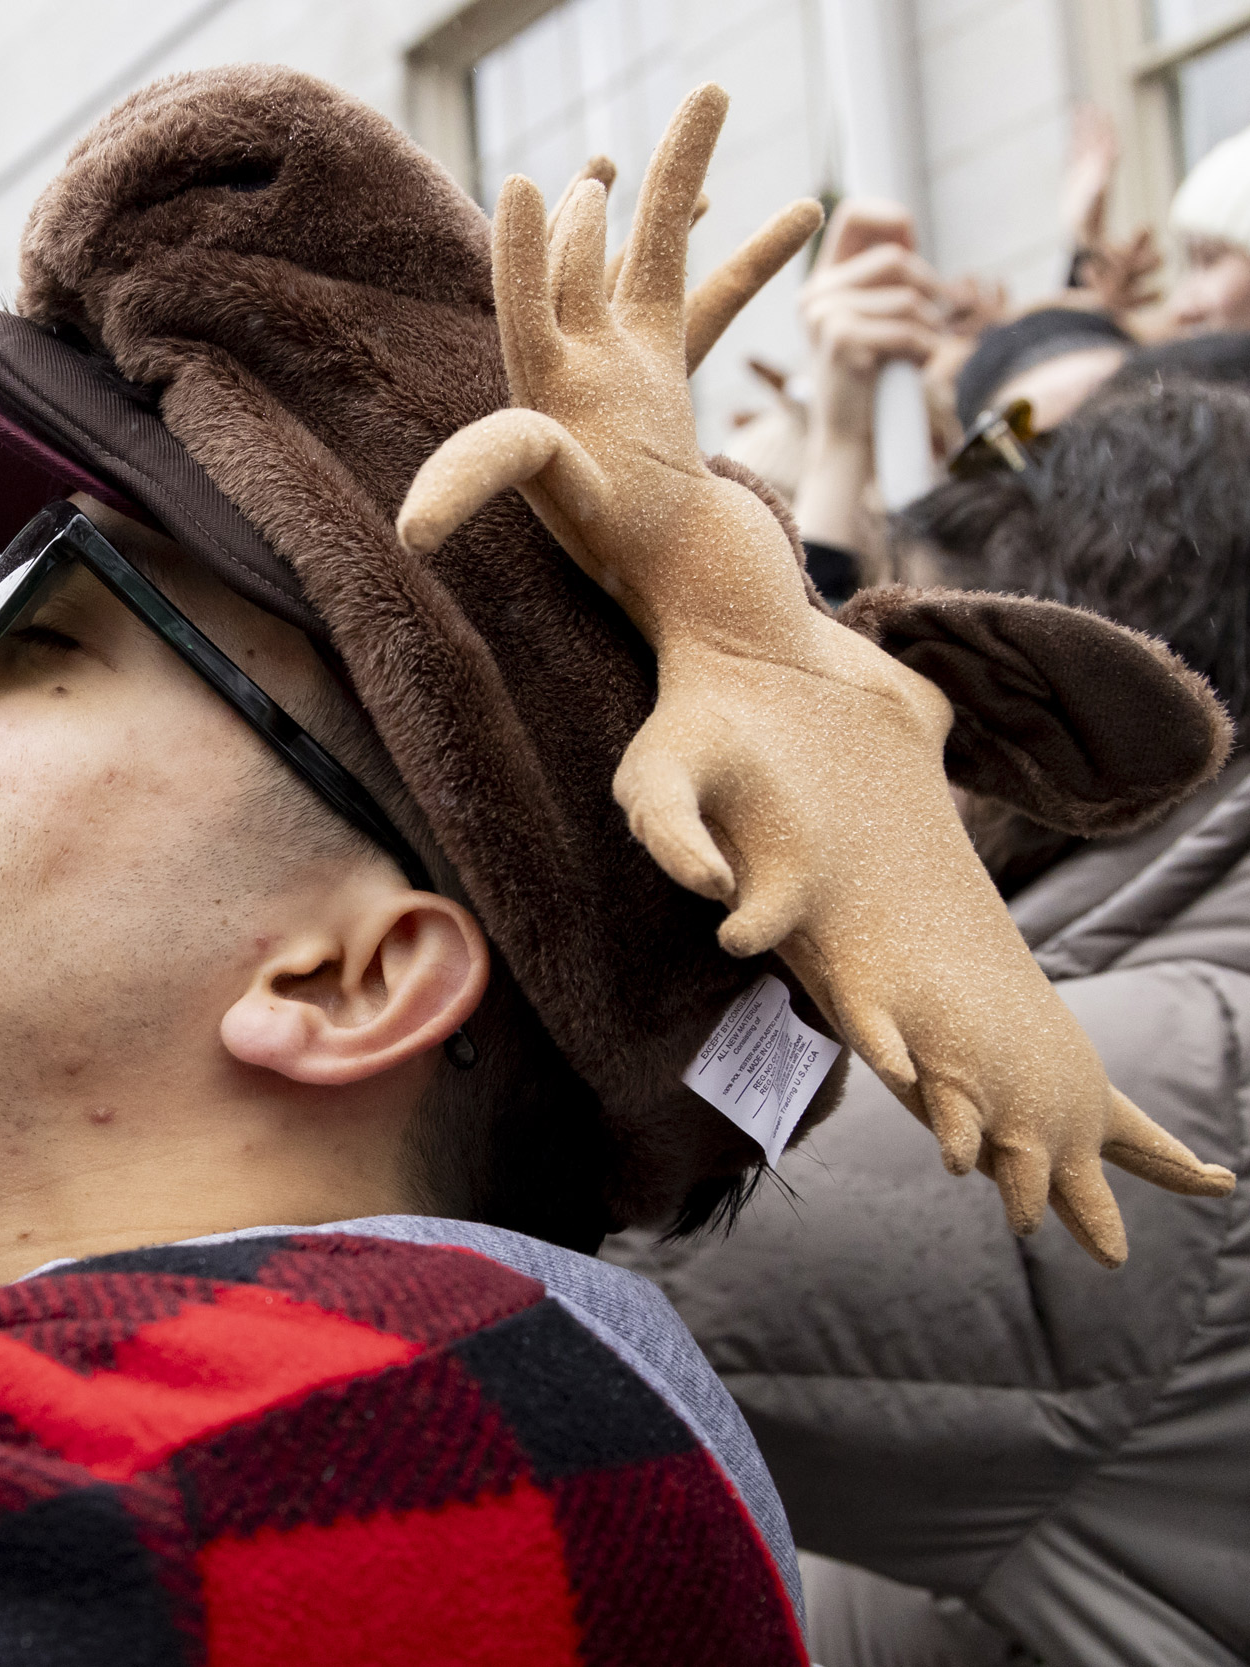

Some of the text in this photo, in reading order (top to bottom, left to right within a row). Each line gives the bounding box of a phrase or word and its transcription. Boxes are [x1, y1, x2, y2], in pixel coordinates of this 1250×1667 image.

[700, 984, 756, 1059] EXCEPT BY CONSUMER
[716, 999, 762, 1062] ALL NEW MATERIAL
[732, 1016, 761, 1055] Consisting of
[751, 1040, 761, 1053] AND
[759, 1020, 776, 1042] PLASTIC
[746, 1028, 778, 1074] MADE IN CHINA
[780, 1086, 798, 1114] Trading
